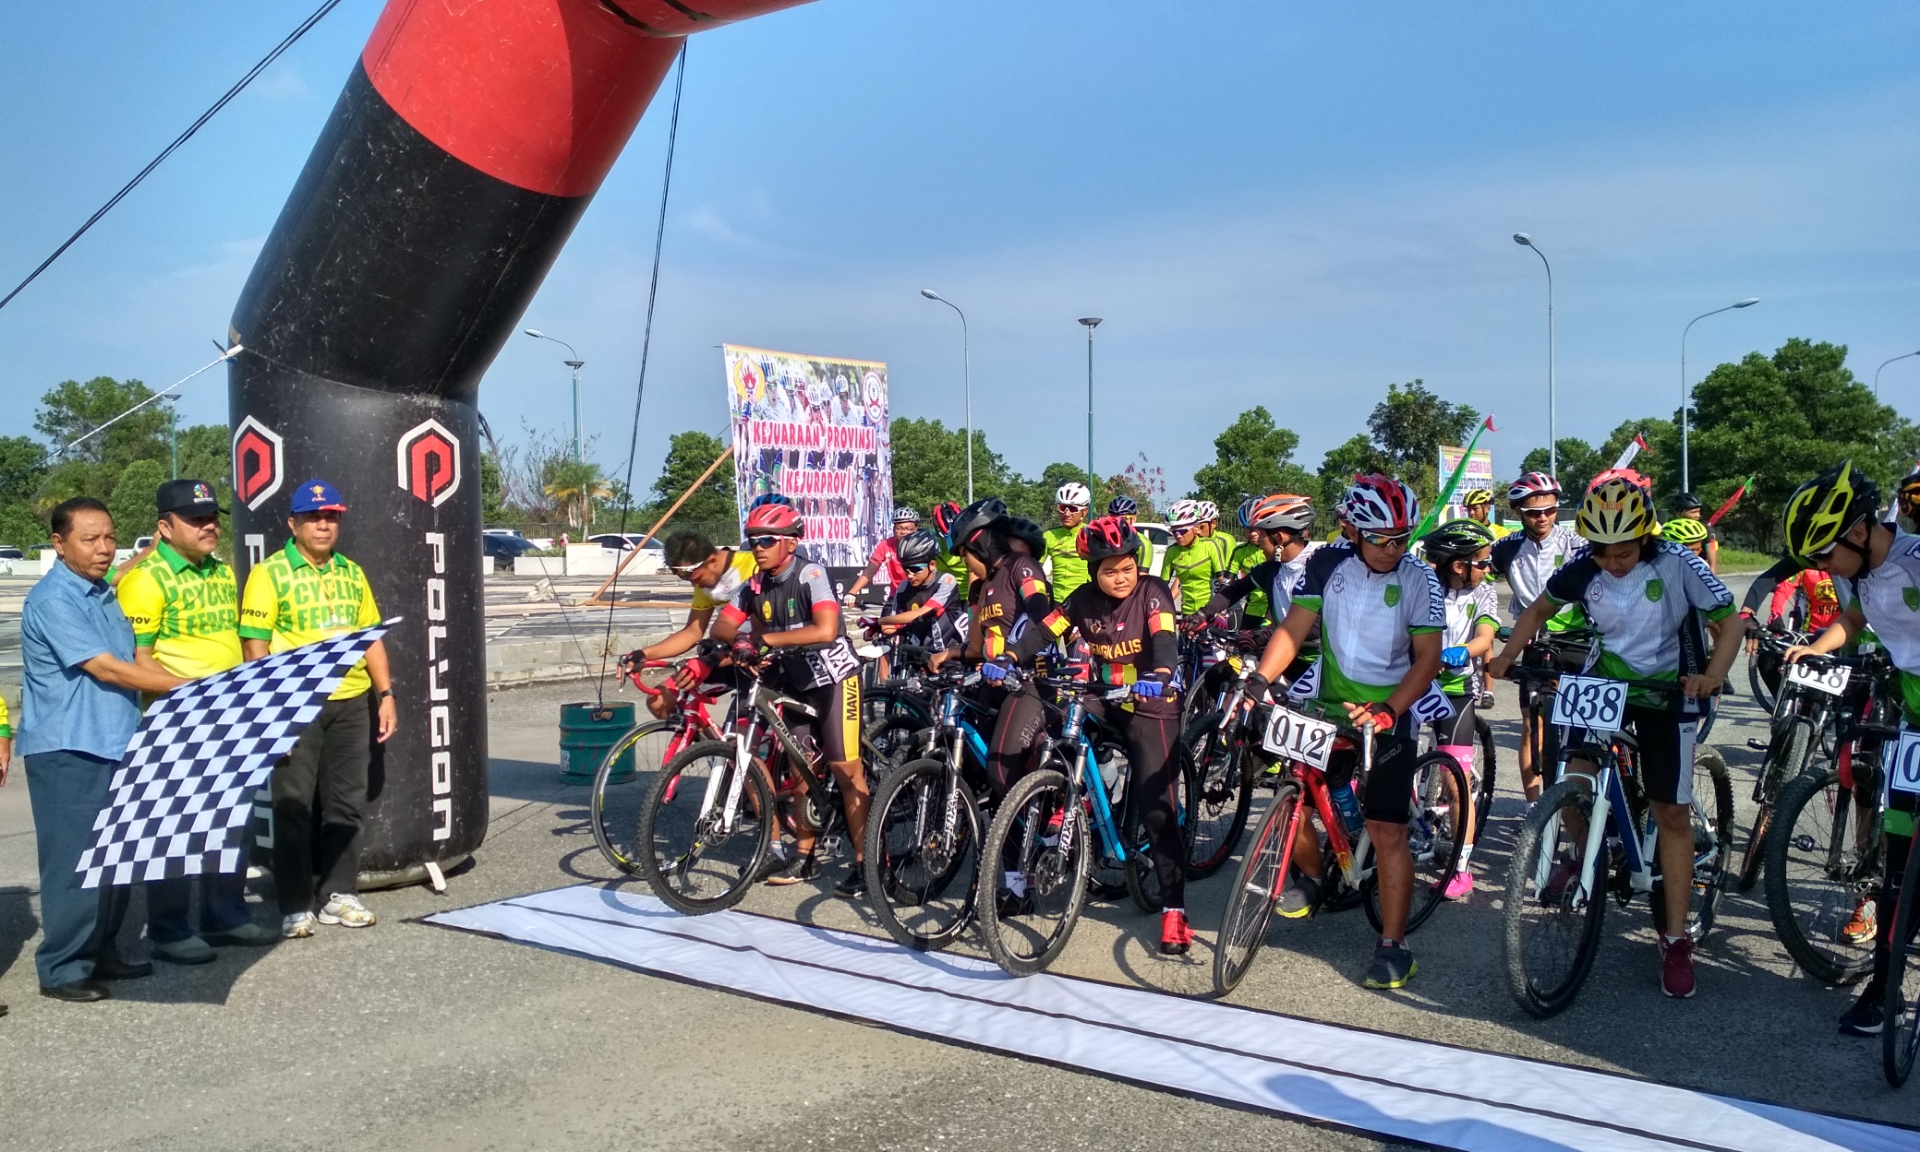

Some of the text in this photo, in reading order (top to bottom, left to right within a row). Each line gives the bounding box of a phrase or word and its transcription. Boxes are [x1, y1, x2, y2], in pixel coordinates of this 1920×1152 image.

[753, 421, 876, 450] KEJUARAAN PROVINSI
[828, 516, 849, 541] 2018
[827, 642, 856, 677] 020
[1560, 682, 1621, 723] 038
[1271, 715, 1327, 762] 012
